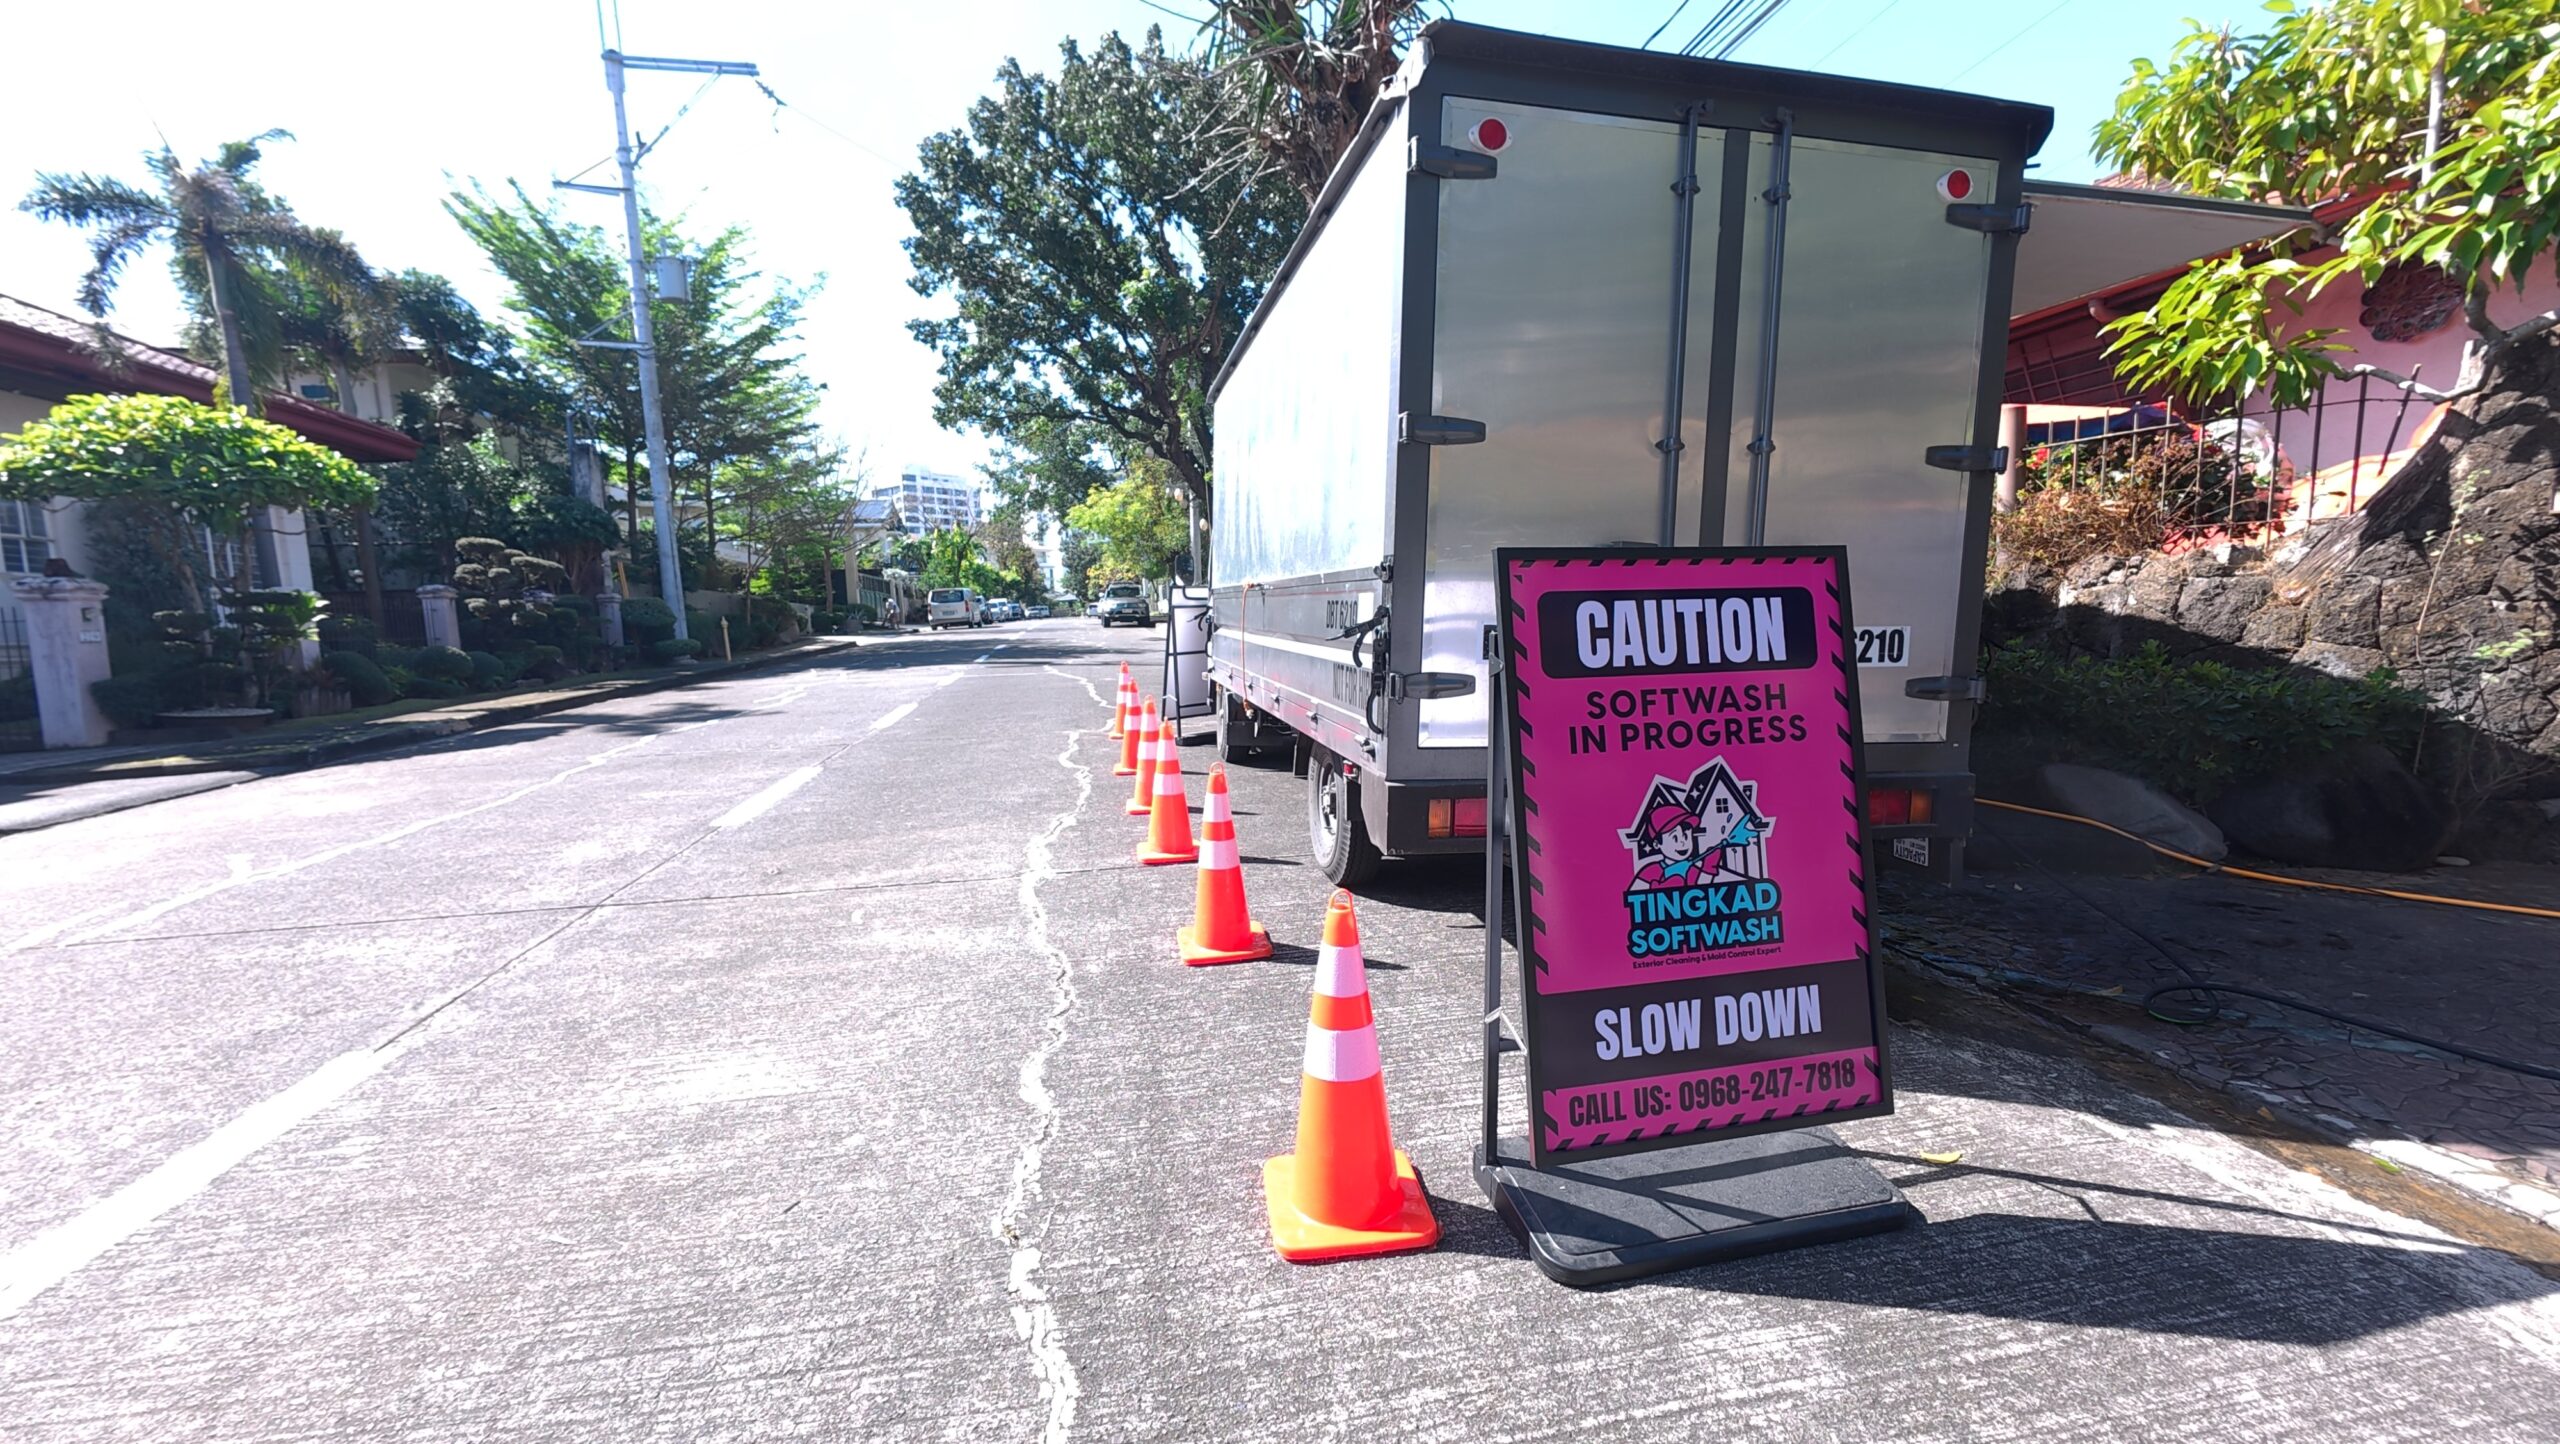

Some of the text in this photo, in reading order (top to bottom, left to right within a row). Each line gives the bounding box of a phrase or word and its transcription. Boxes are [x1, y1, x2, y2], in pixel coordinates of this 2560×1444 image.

[1326, 600, 1358, 629] DBT 6210
[1575, 597, 1787, 669] CAUTION
[1853, 628, 1905, 663] 210
[1332, 662, 1344, 702] NOT
[1345, 665, 1357, 706] FOR
[1586, 683, 1787, 719] SOFTWASH
[1568, 714, 1807, 754] IN PROGRESS
[1895, 844, 1926, 865] CAPACITY
[1627, 883, 1778, 924] TINGKAD
[1631, 916, 1780, 954] SOFTWASH
[1632, 961, 1664, 969] Exterior
[1666, 957, 1700, 966] Cleaning
[1707, 953, 1727, 961] Mold
[1728, 950, 1755, 959] Control
[1757, 948, 1781, 957] Expert
[1594, 984, 1822, 1061] SLOW DOWN
[1569, 1057, 1856, 1127] CALL US: 0968-247-7818
